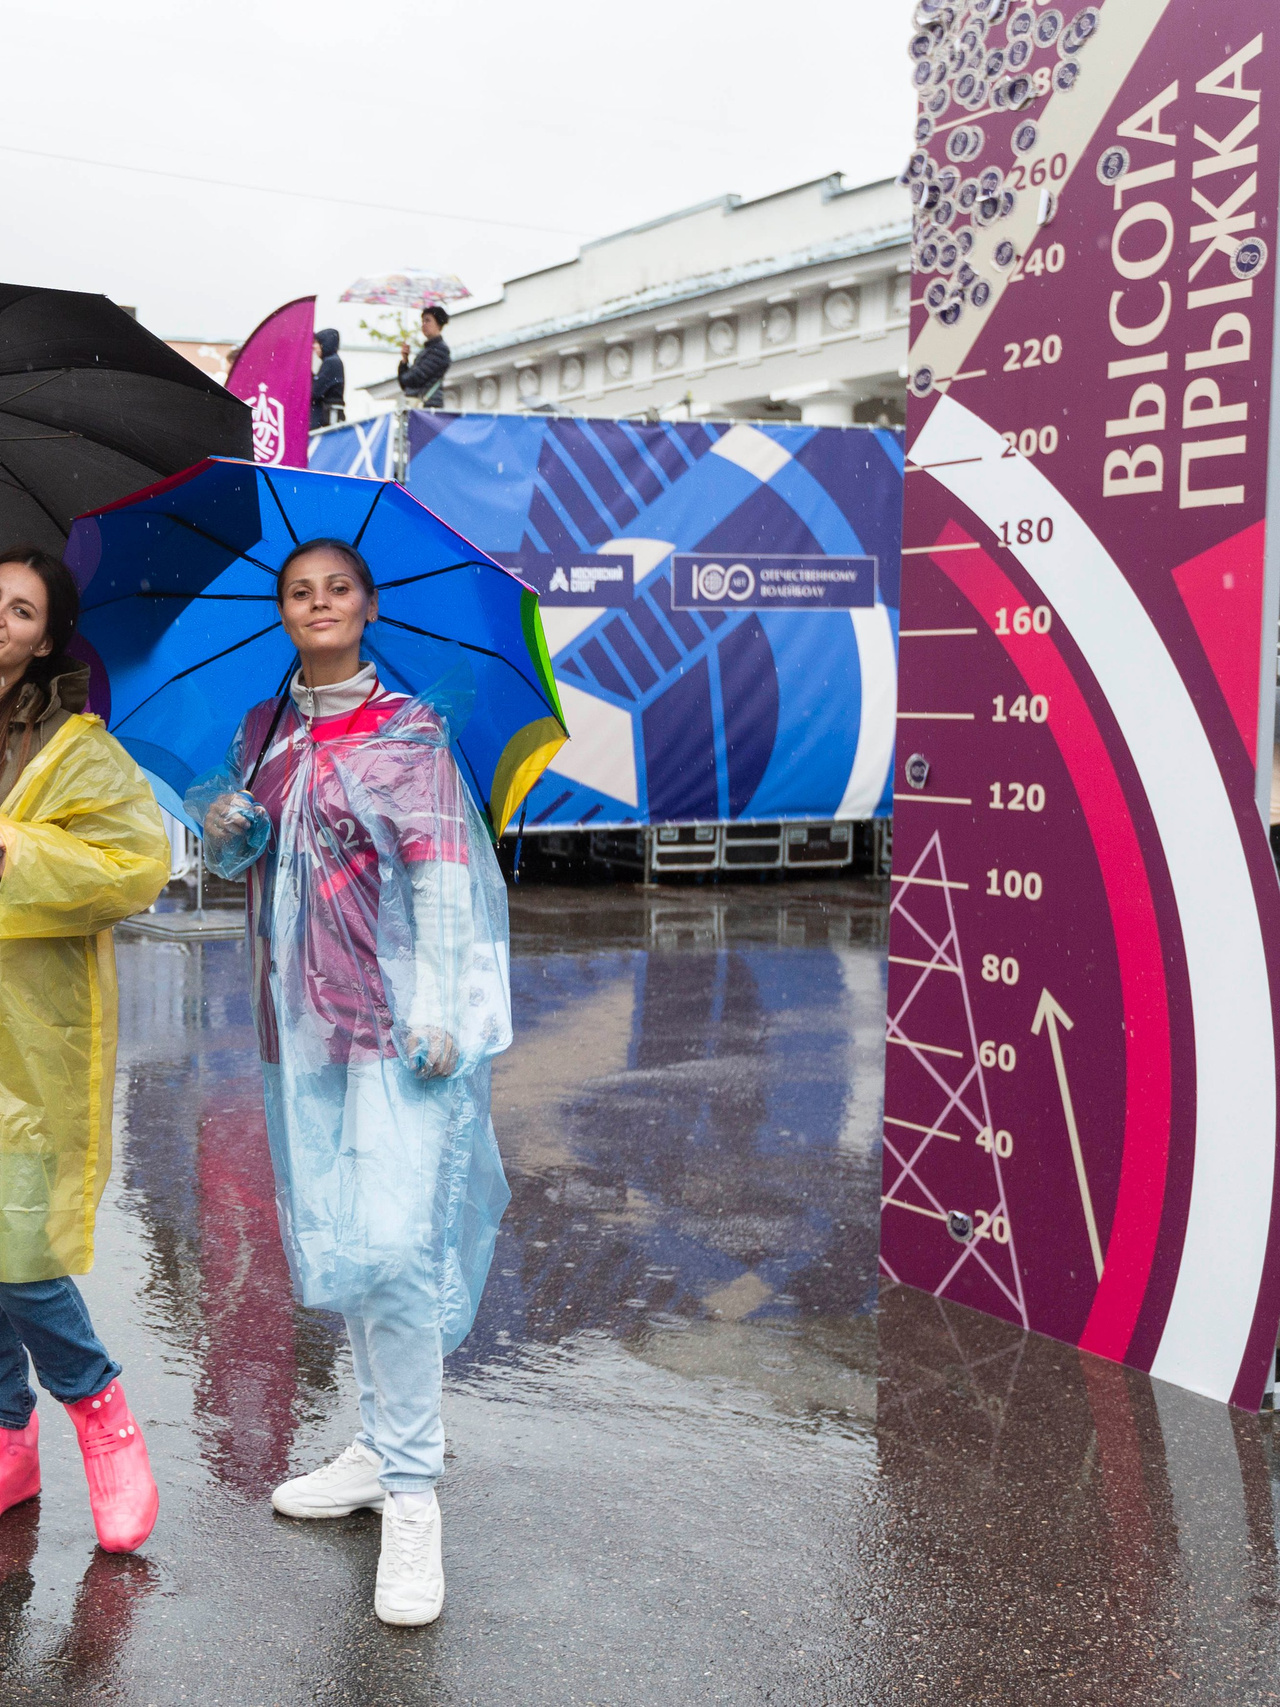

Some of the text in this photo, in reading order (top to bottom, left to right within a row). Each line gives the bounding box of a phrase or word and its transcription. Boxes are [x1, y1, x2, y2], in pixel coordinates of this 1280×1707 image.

[1011, 152, 1068, 191] 260
[1179, 32, 1264, 508] ПРЫЖКА
[1103, 79, 1179, 497] ВЫСОТА
[1003, 334, 1063, 372] 220
[1001, 425, 1059, 459] 200
[998, 517, 1054, 546] 180
[691, 563, 756, 601] 100
[994, 605, 1053, 636] 160
[991, 694, 1050, 724] 140
[988, 781, 1046, 813] 120
[986, 868, 1043, 901] 100
[981, 953, 1020, 986] 80
[978, 1040, 1017, 1073] 60
[975, 1126, 1013, 1158] 40
[973, 1209, 1011, 1244] 20
